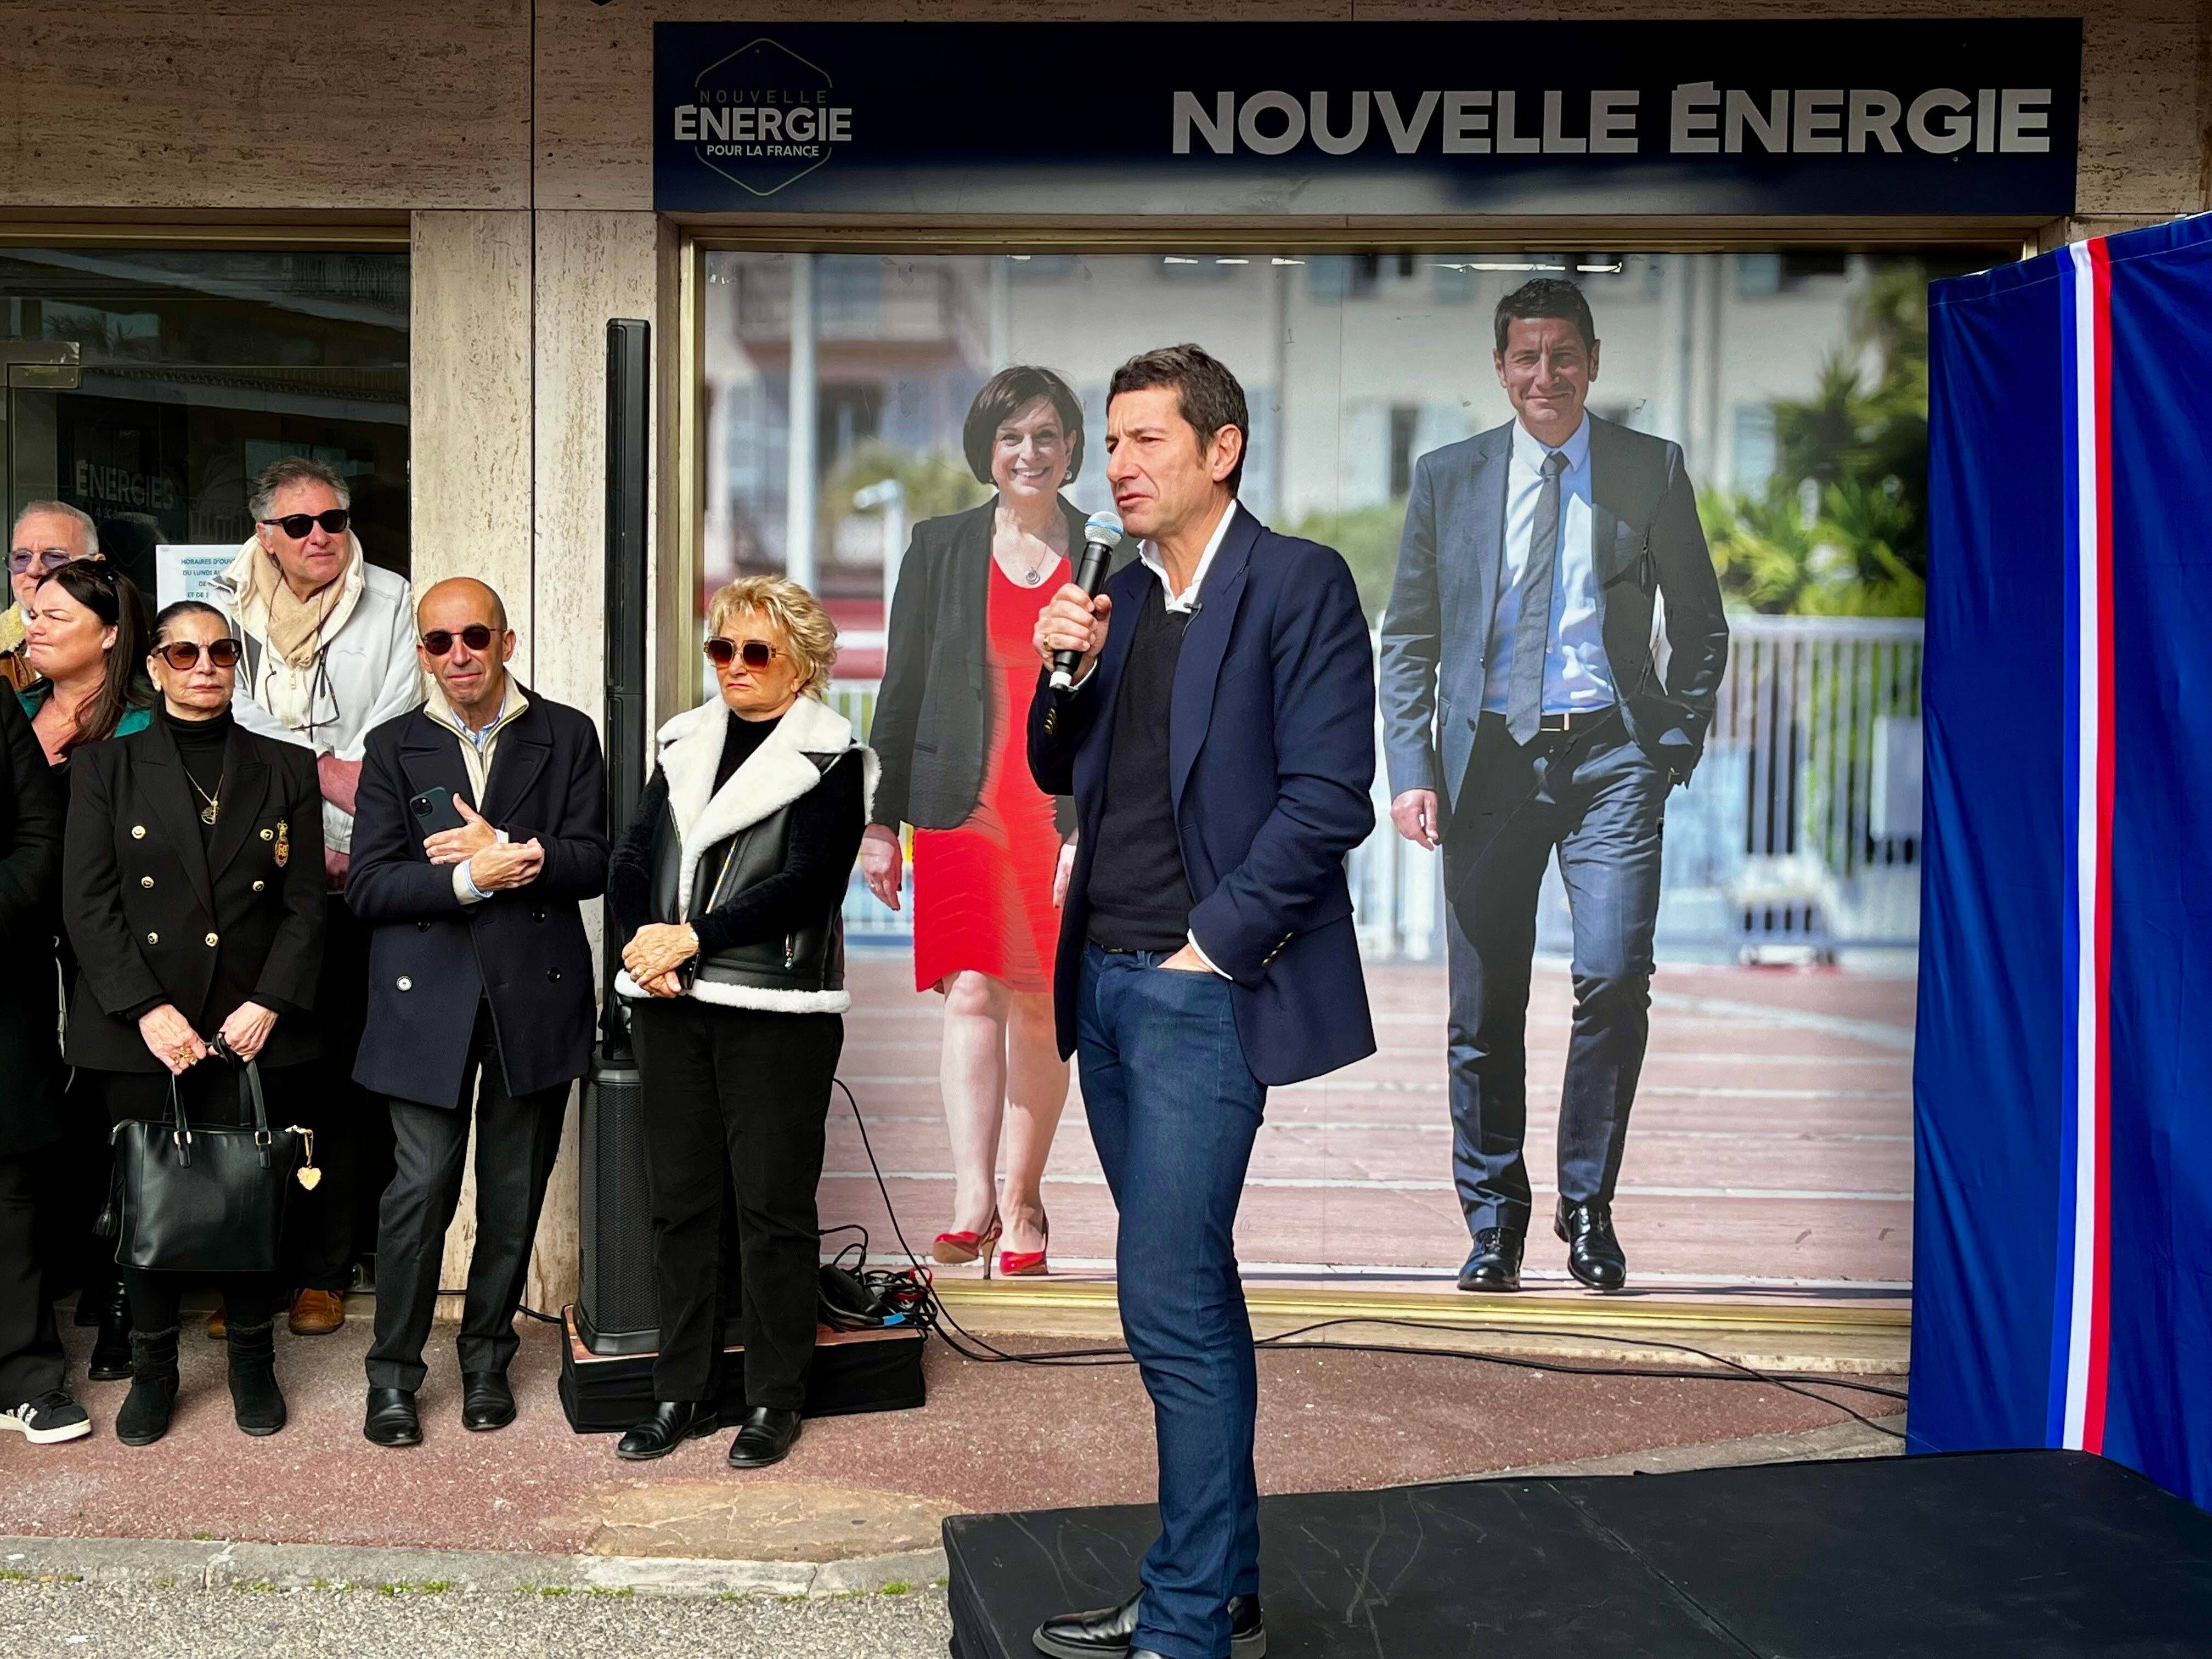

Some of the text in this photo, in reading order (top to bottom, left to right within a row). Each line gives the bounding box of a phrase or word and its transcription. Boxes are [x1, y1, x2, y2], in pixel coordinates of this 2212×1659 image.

[701, 91, 827, 104] NOUVELLE
[675, 104, 853, 142] ÉNERGIE
[1172, 81, 2051, 154] NOUVELLE ÉNERGIE
[707, 145, 820, 157] POUR LA FRANCE
